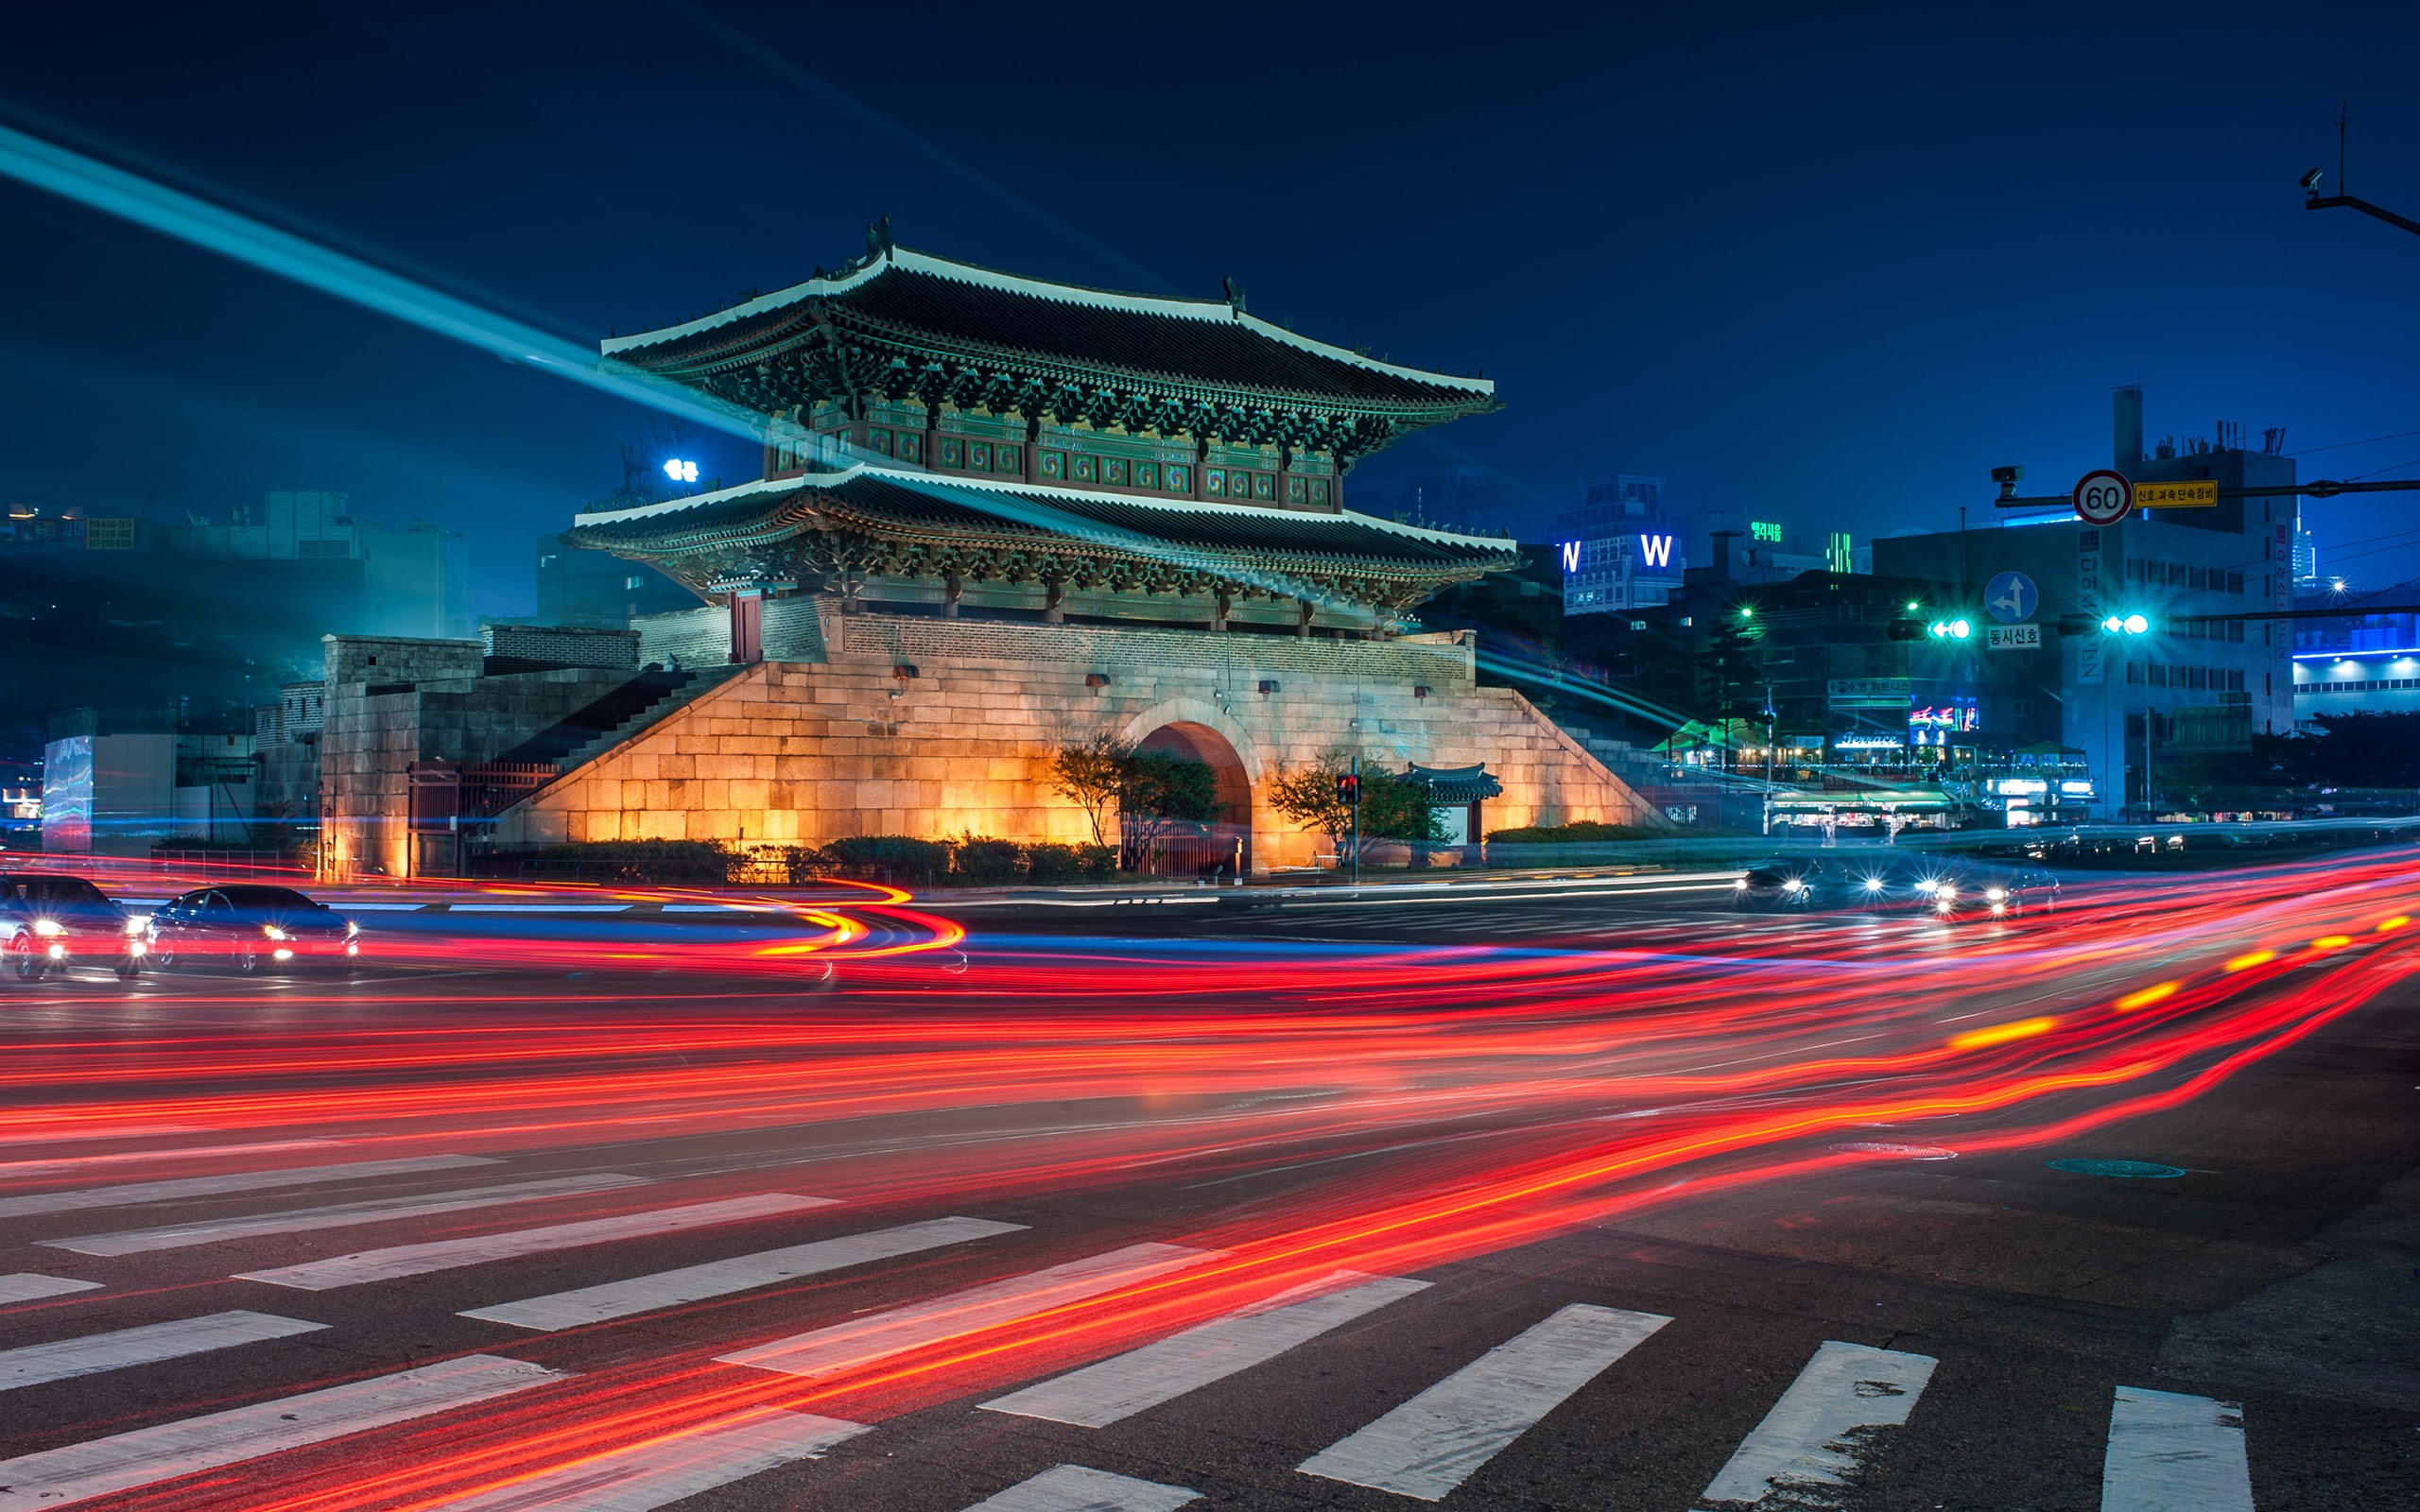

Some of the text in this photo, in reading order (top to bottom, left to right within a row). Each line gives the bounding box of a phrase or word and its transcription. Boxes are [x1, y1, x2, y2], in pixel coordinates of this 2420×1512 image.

[2086, 487, 2119, 509] 60
[1640, 534, 1672, 567] W
[1990, 628, 2038, 645] 동시신호
[1842, 731, 1897, 745] Terrace
